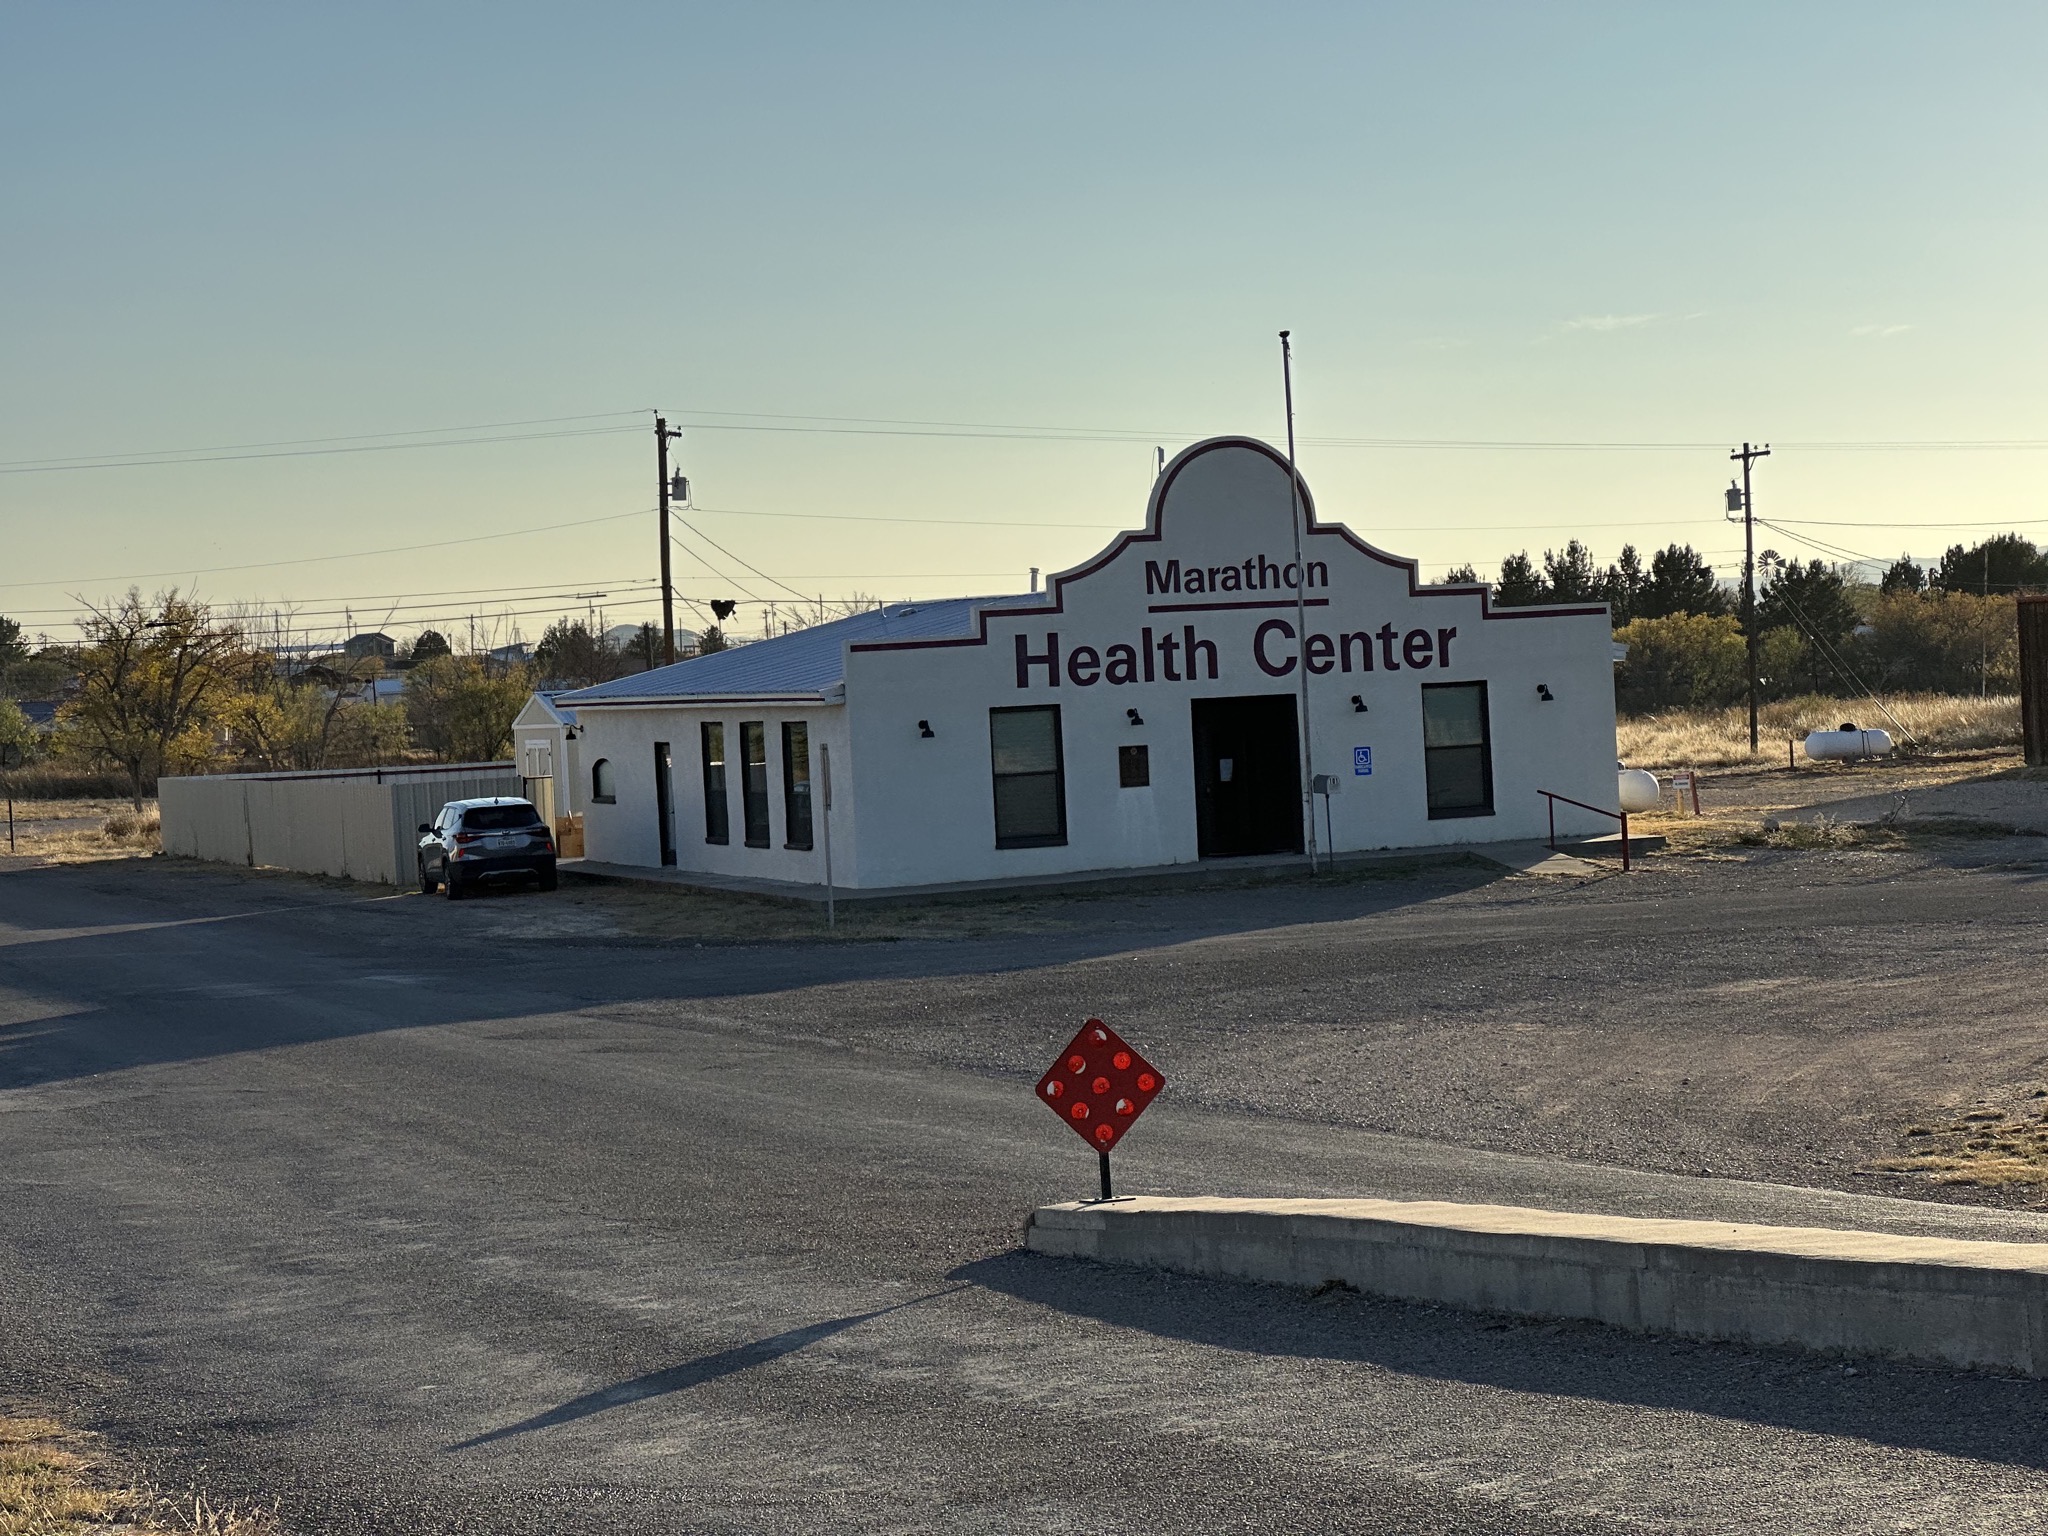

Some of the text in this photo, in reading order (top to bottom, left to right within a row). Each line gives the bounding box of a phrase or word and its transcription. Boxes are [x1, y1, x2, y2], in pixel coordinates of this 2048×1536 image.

[1145, 554, 1329, 595] Marathon
[1015, 618, 1457, 689] Health Center
